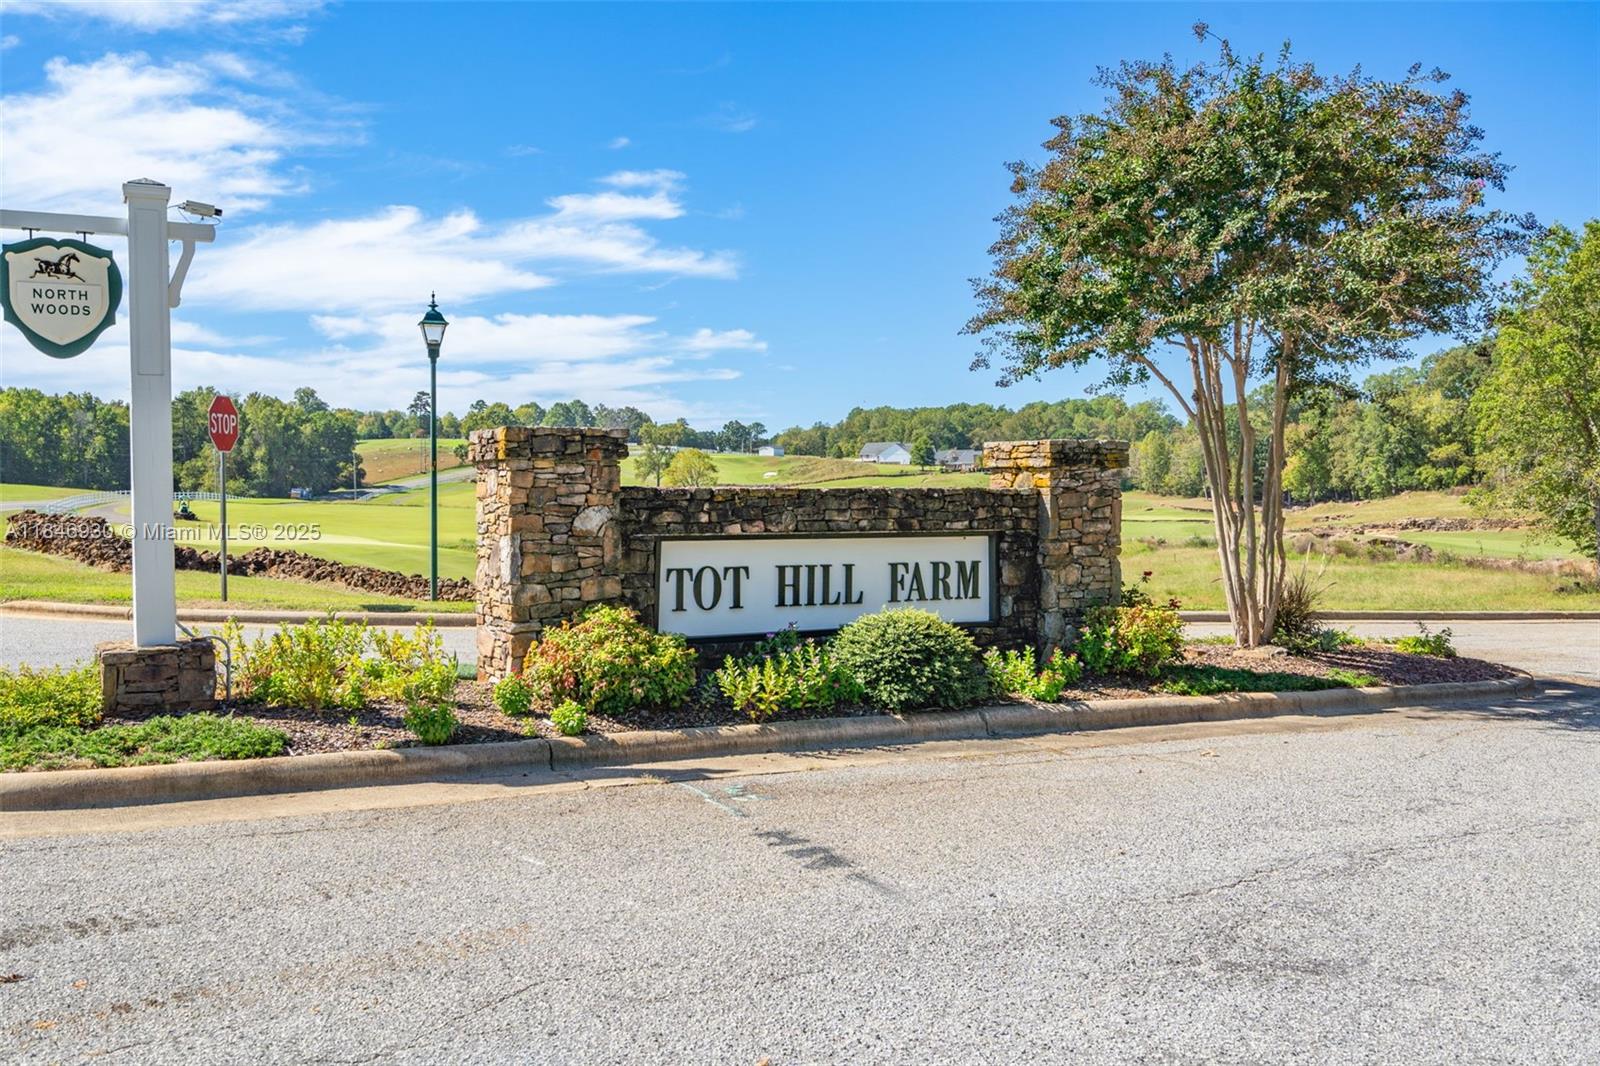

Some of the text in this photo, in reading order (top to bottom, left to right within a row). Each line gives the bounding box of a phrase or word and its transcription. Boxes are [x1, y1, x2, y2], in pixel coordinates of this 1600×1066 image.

[33, 288, 88, 300] NORTH
[31, 303, 91, 316] WOODS
[211, 412, 237, 434] STOP
[666, 560, 981, 612] TOT HILL FARM
